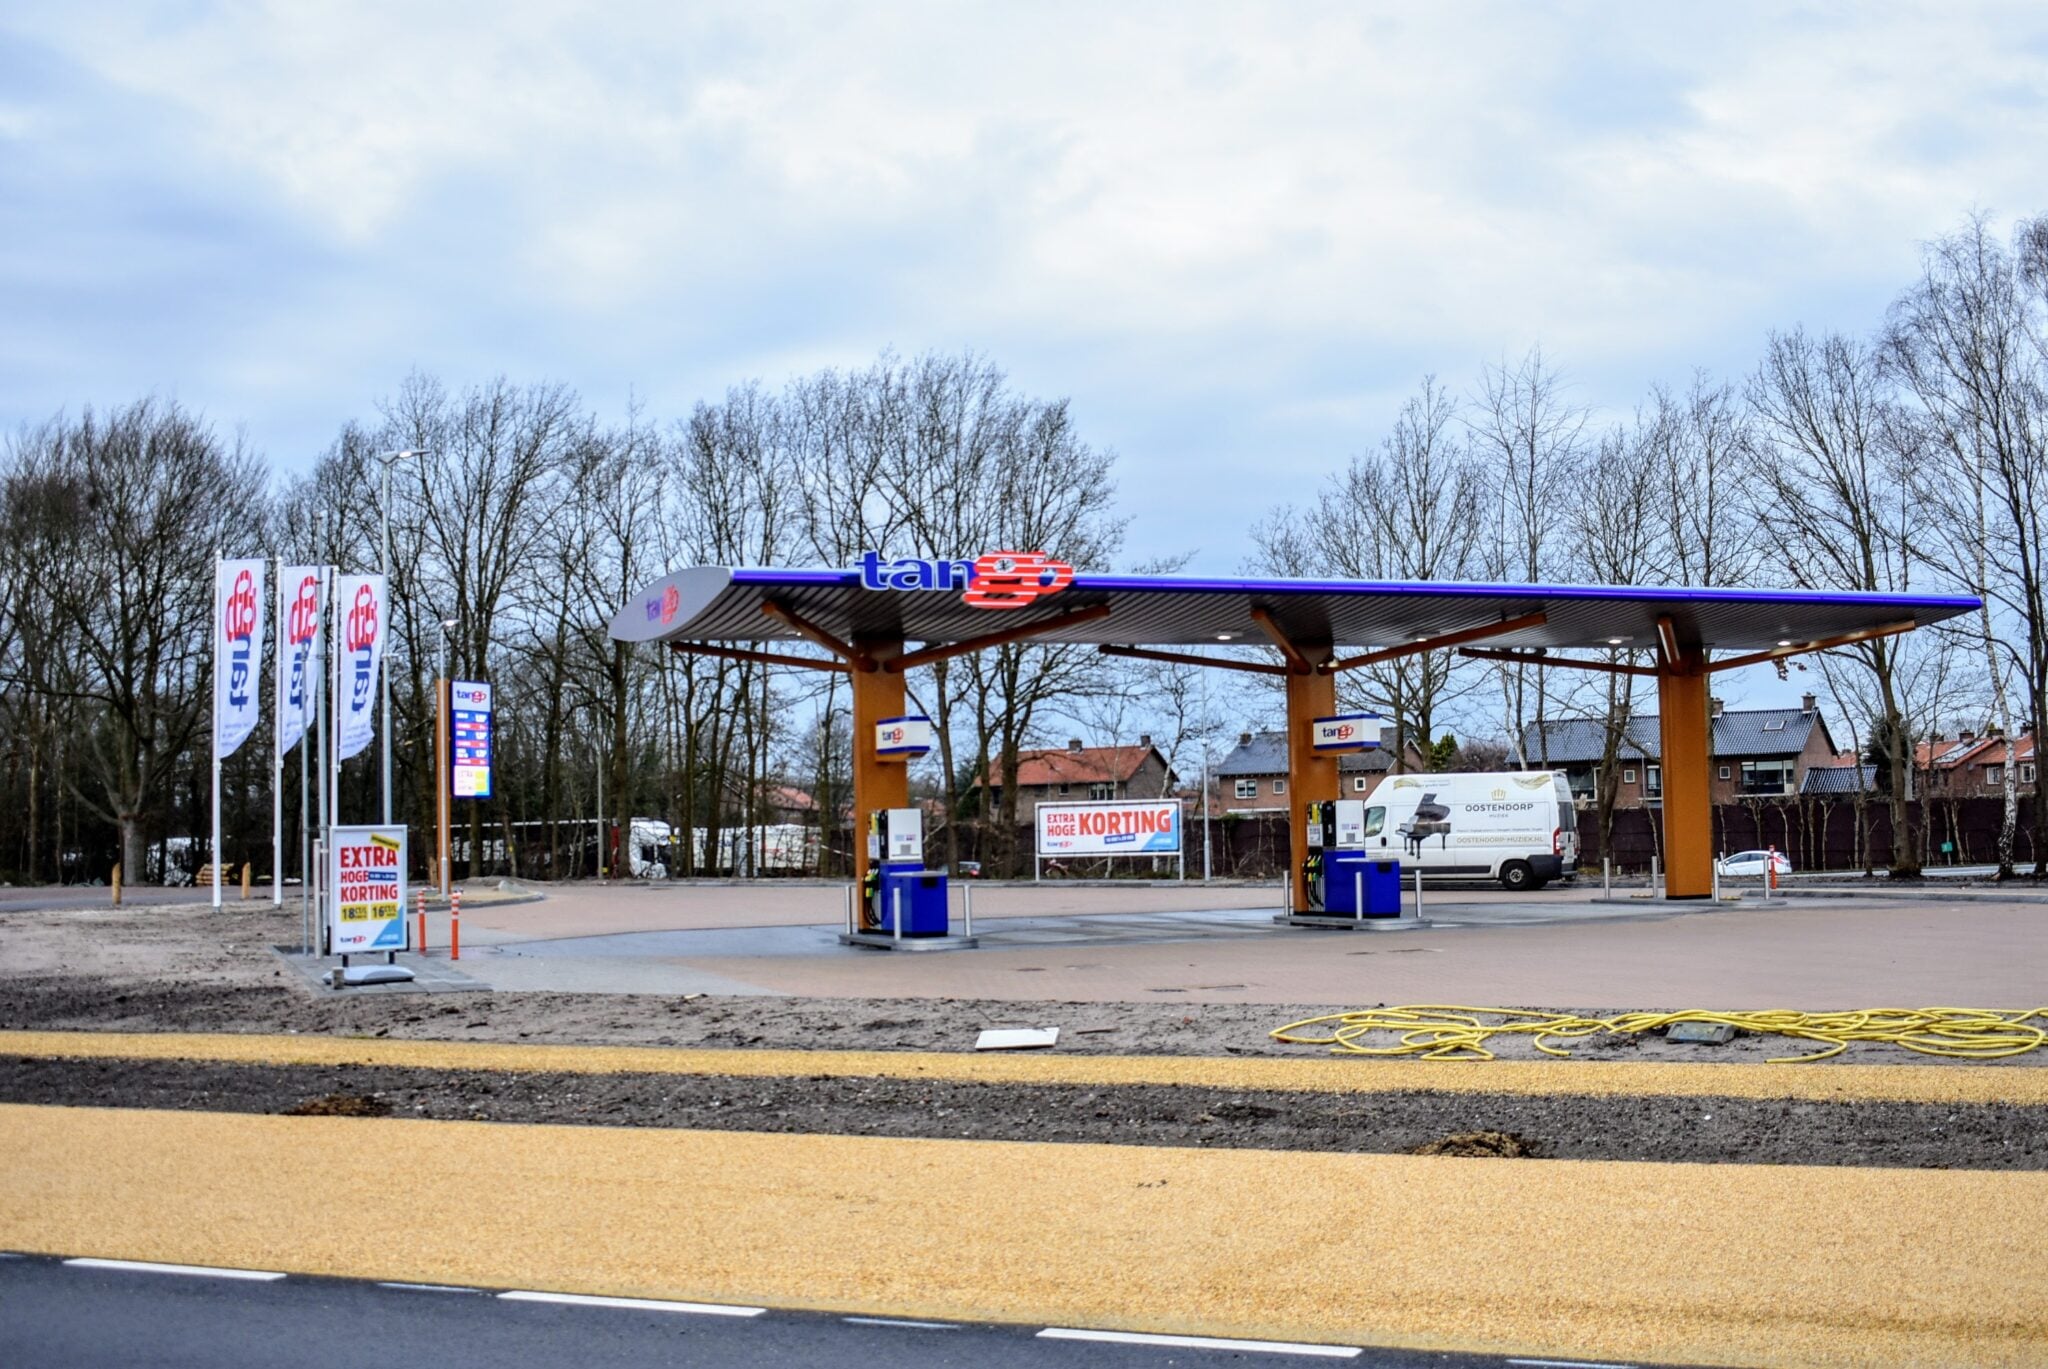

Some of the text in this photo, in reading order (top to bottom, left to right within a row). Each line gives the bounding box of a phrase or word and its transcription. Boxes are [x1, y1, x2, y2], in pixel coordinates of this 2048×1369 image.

[855, 549, 1074, 609] tango
[646, 584, 680, 624] tango
[456, 690, 487, 703] tango
[1322, 725, 1354, 740] tango
[1465, 803, 1534, 812] OOSTENDORP
[1047, 813, 1075, 823] EXTRA
[1079, 809, 1171, 836] KORTING
[1047, 825, 1075, 836] HOGE
[340, 846, 397, 868] EXTRA
[340, 870, 369, 883] HOGE
[340, 884, 398, 902] KORTING
[342, 907, 355, 920] 18
[372, 906, 385, 918] 16
